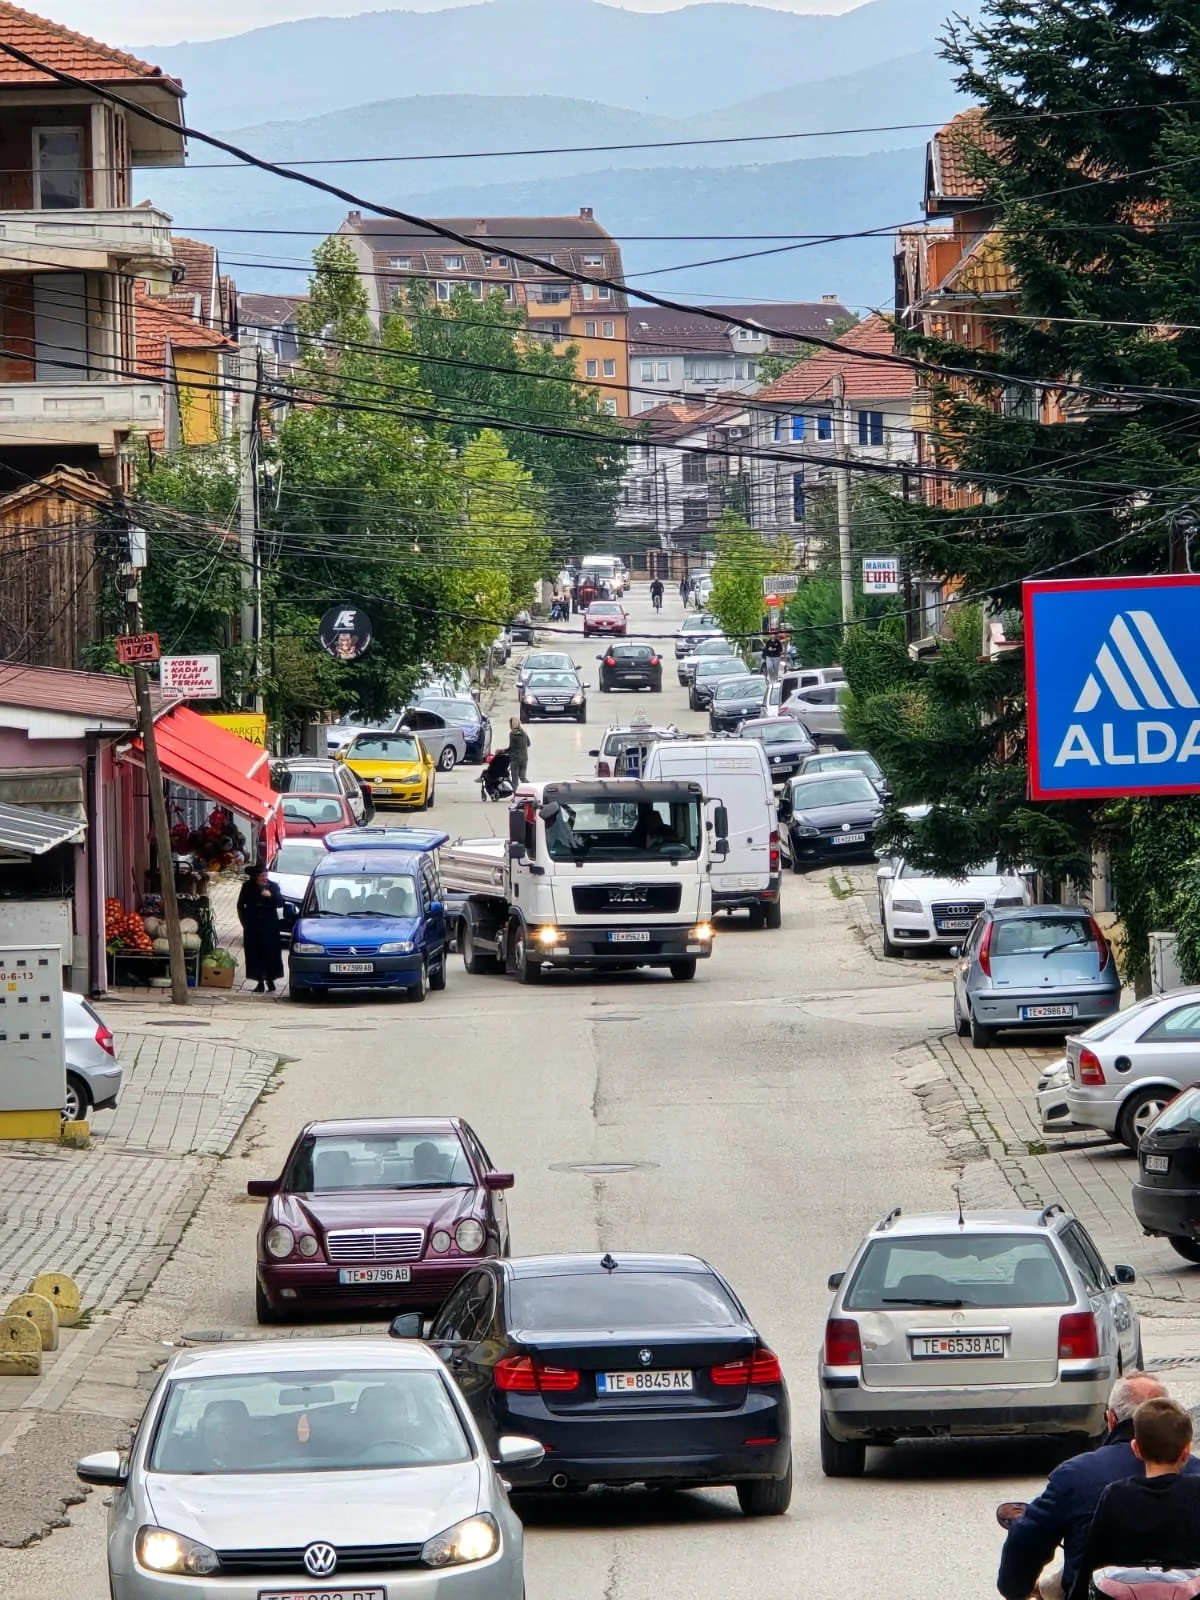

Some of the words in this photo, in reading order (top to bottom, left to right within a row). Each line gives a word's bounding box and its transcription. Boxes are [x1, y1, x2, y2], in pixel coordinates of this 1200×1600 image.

[866, 561, 894, 569] MARKET
[125, 643, 153, 655] 178
[1029, 1007, 1038, 1017] TE
[347, 1270, 360, 1281] TE
[366, 1269, 393, 1281] 9796
[395, 1269, 408, 1280] AB
[923, 1339, 940, 1353] TE
[948, 1338, 981, 1353] 6538
[984, 1338, 1000, 1352] AC
[607, 1374, 625, 1390] TE
[635, 1373, 671, 1388] 8845
[673, 1372, 690, 1388] AK
